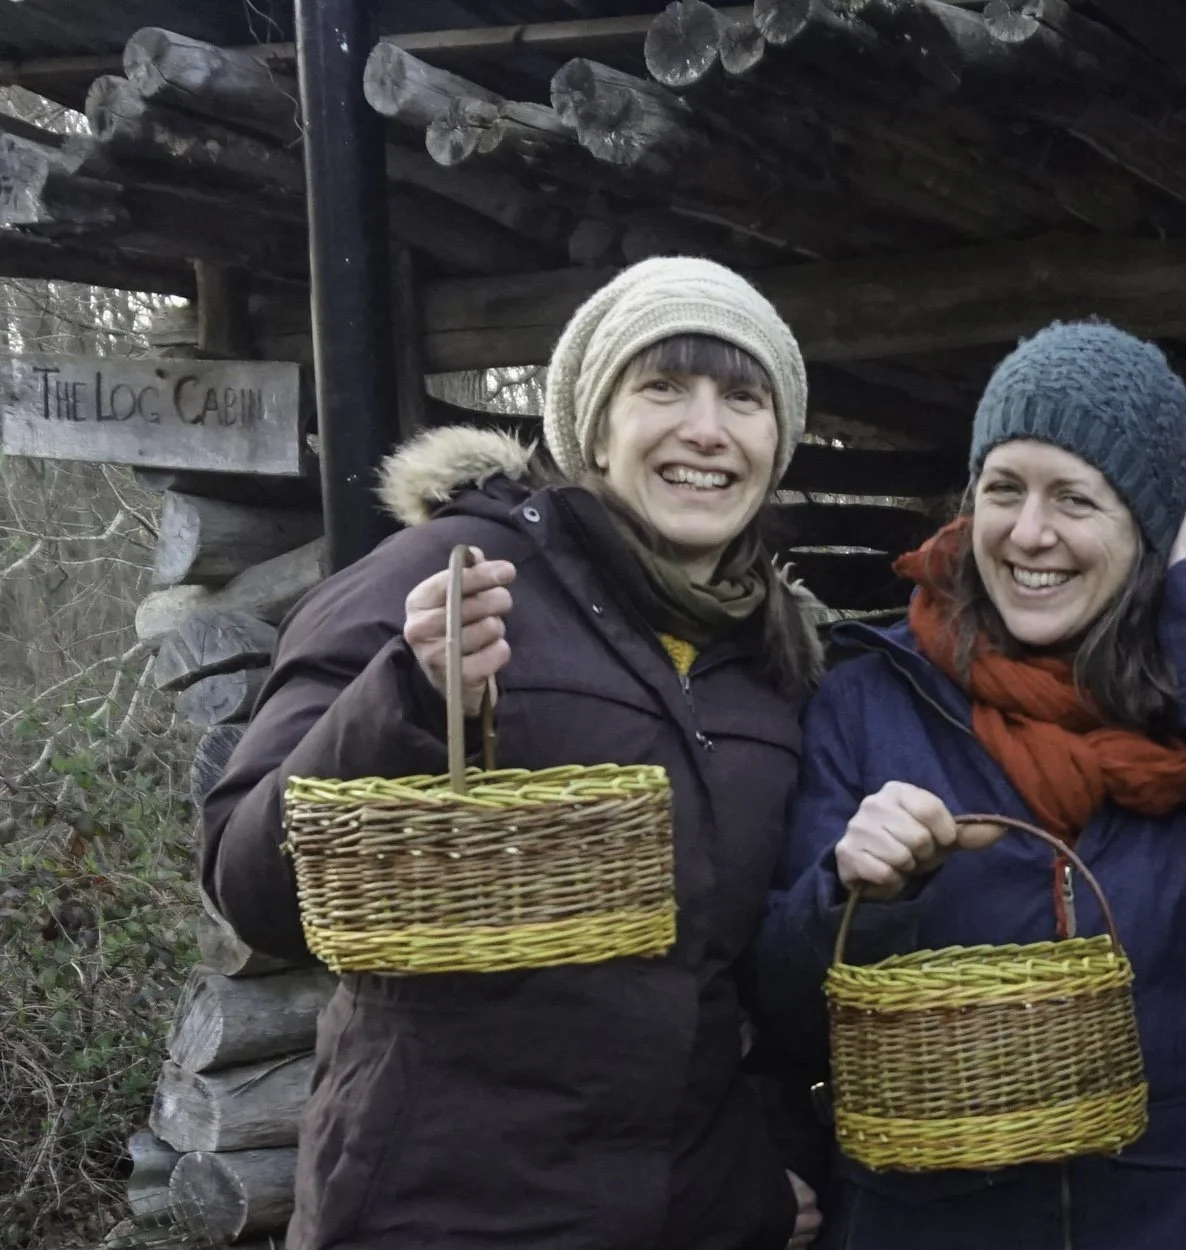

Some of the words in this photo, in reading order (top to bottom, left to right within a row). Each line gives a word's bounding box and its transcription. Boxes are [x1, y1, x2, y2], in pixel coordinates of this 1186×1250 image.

[33, 366, 87, 422] THE
[95, 371, 161, 423] LOG
[174, 375, 263, 426] CABIN
